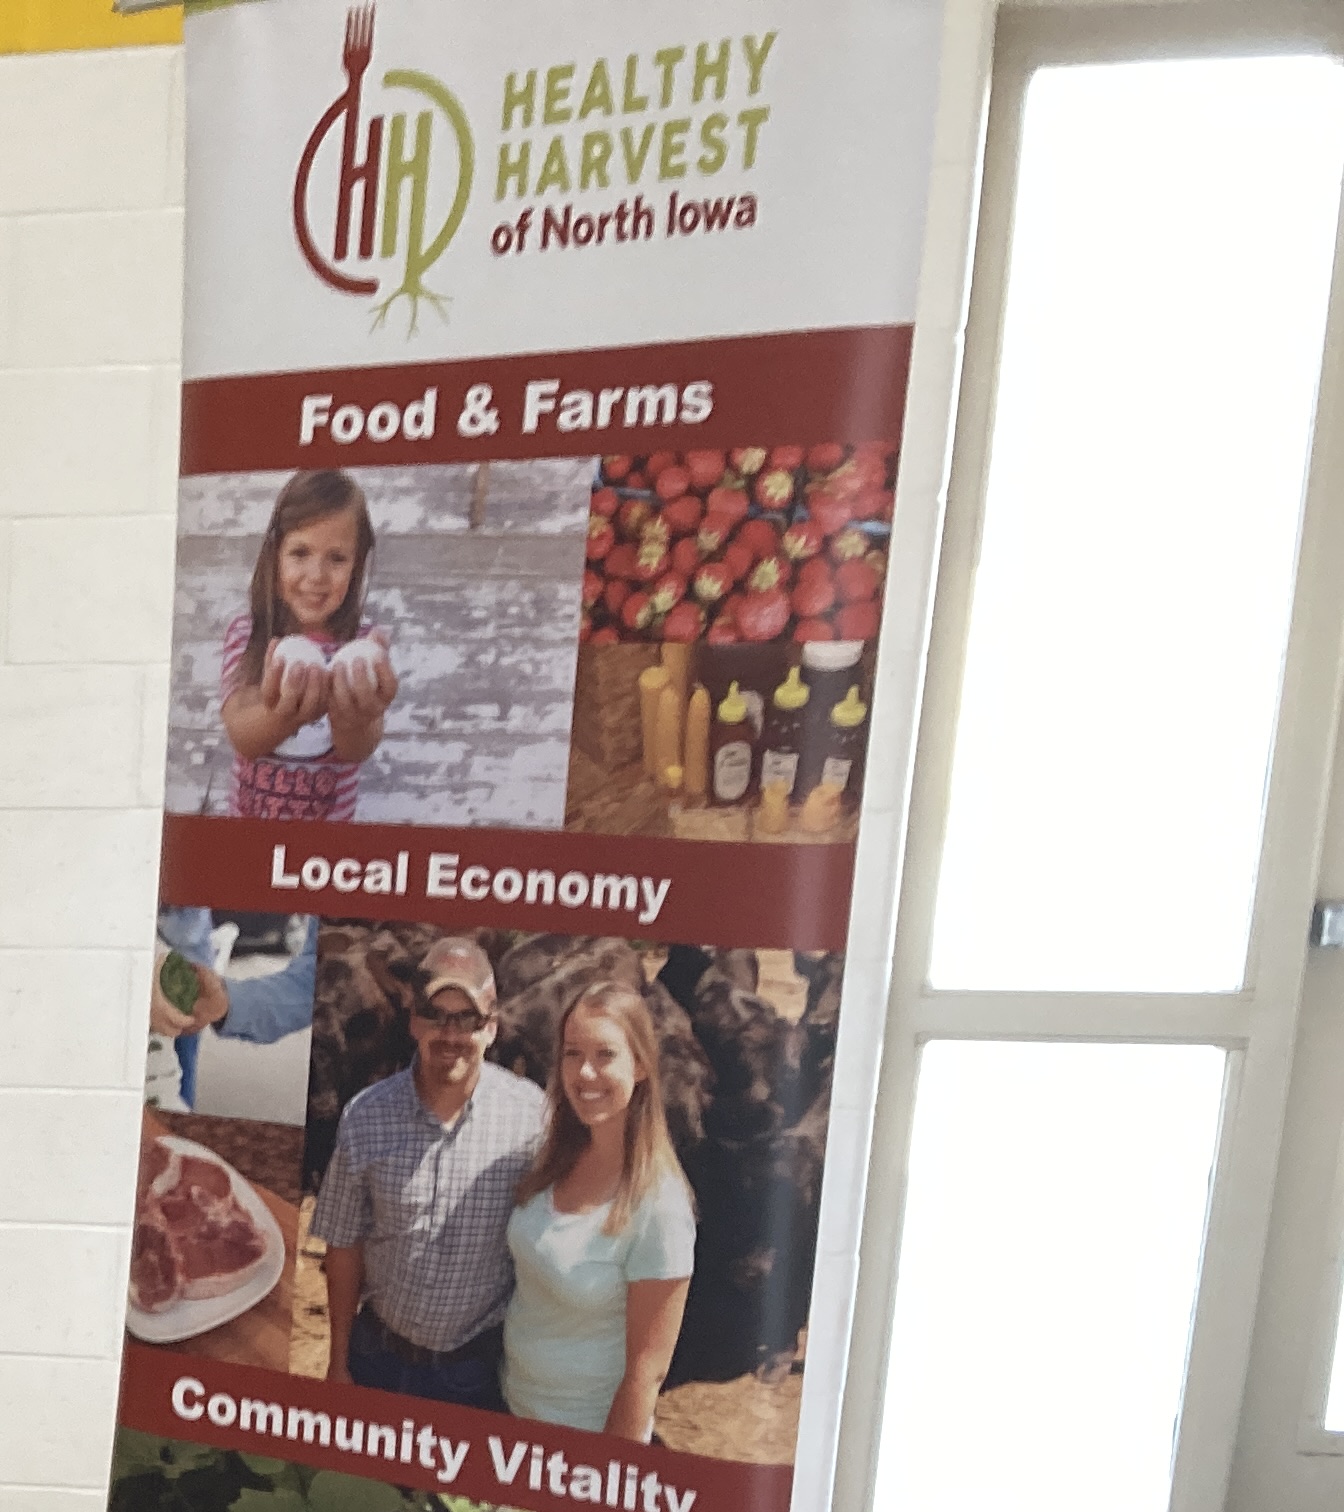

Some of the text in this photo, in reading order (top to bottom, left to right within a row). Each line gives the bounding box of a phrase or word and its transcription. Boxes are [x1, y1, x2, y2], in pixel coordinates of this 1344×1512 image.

[501, 31, 778, 131] HEALTHY
[494, 105, 771, 202] HARVEST
[490, 190, 759, 258] of North Iowa
[298, 379, 714, 446] Food & Farms
[271, 844, 671, 924] Local Economy
[171, 1376, 469, 1484] Community
